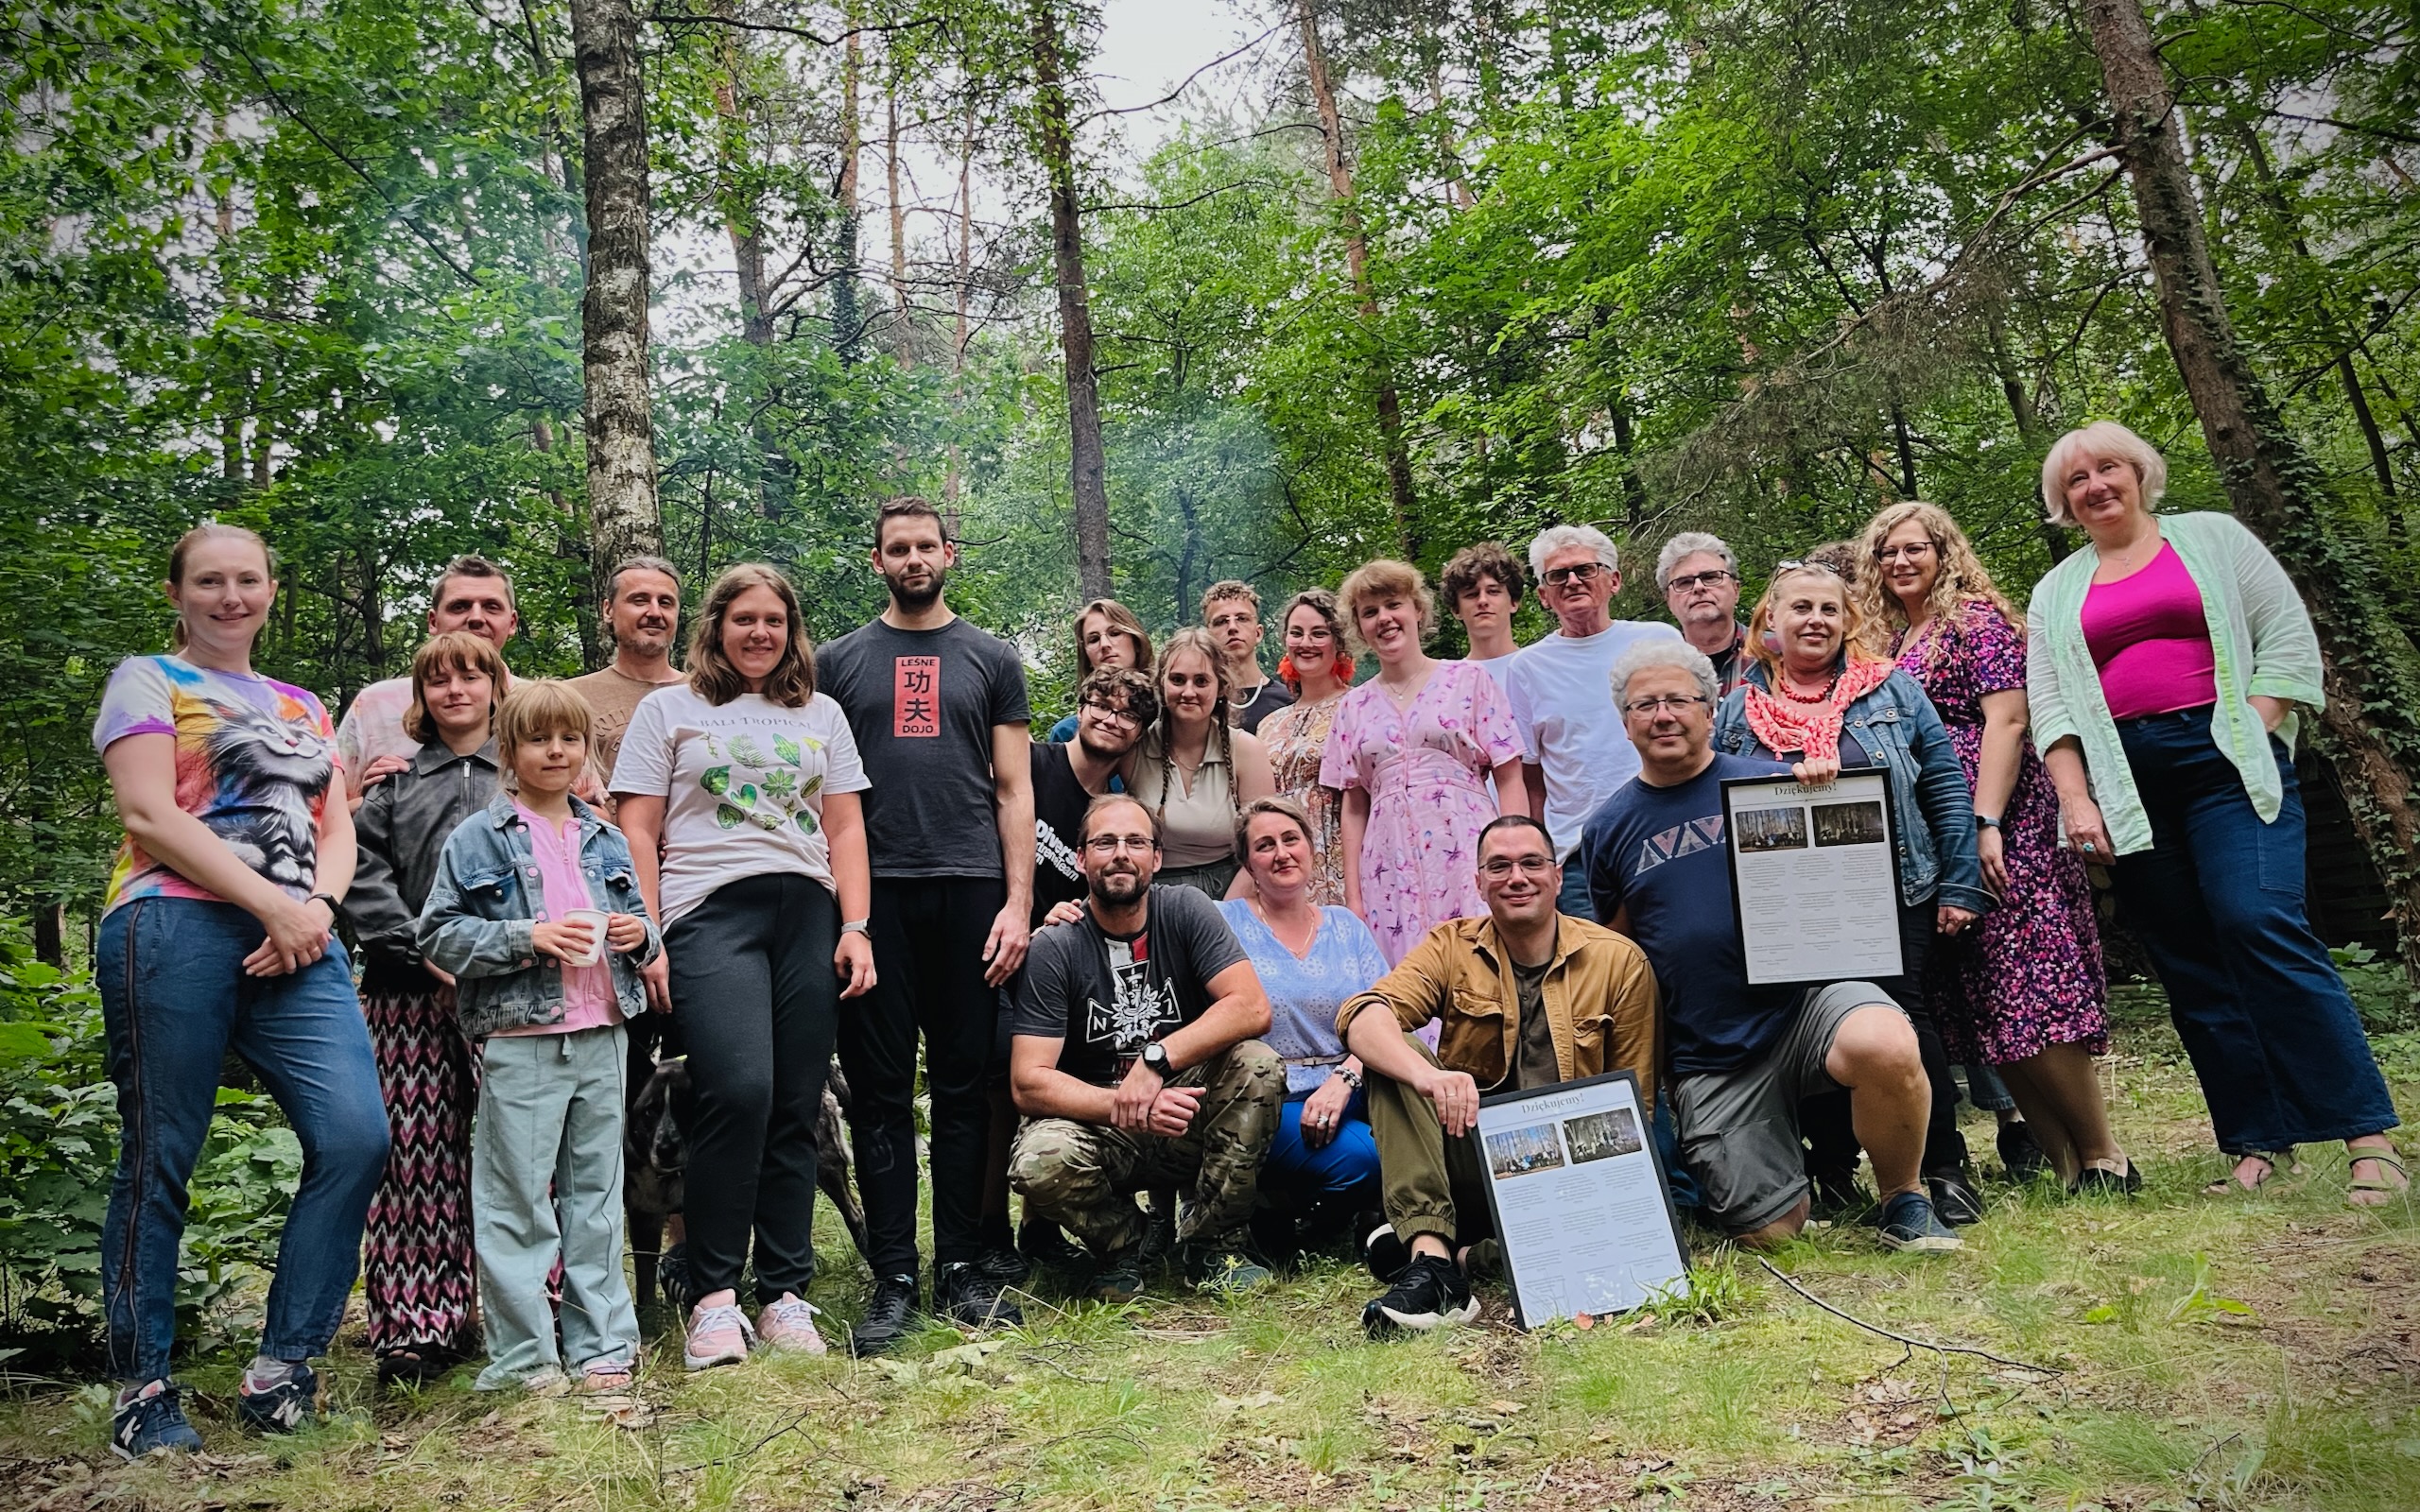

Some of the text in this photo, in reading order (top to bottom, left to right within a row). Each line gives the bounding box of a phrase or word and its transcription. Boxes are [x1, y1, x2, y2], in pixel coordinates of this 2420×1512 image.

[901, 658, 936, 667] LEŚNE
[904, 670, 931, 722] 功夫
[902, 725, 934, 733] DOJO
[1774, 782, 1837, 796] Dziękujemy!
[1035, 818, 1080, 872] Divers
[1093, 1016, 1107, 1031] N
[1521, 1092, 1584, 1113] Dziękujemy!
